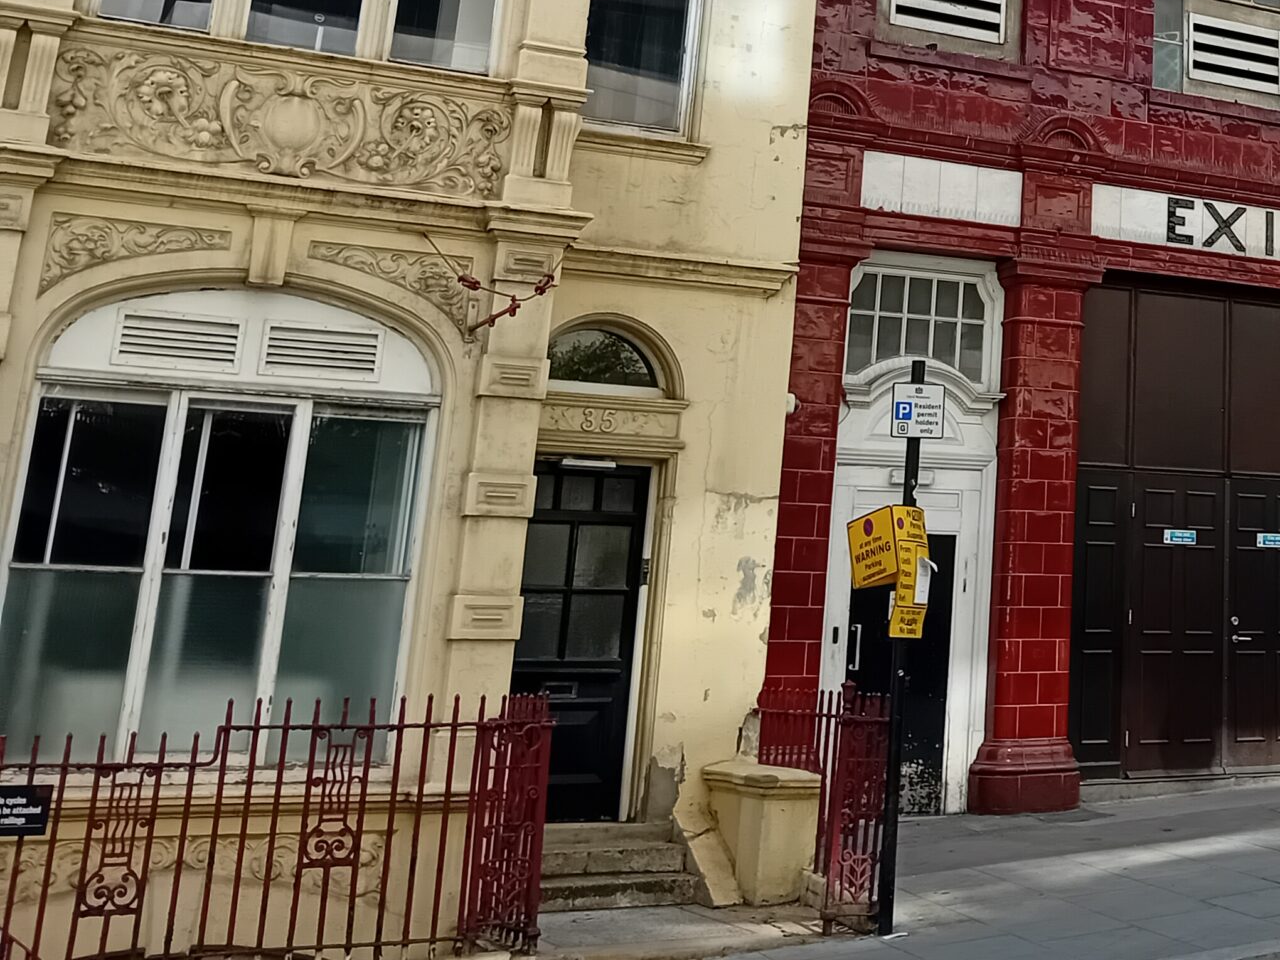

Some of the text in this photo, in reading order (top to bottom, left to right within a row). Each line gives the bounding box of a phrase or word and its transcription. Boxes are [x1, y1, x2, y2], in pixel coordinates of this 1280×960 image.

[899, 403, 910, 419] P
[580, 407, 618, 433] 35
[854, 540, 892, 565] WARNING
[864, 559, 883, 571] Parking
[12, 805, 42, 814] attached
[0, 816, 26, 825] railings
